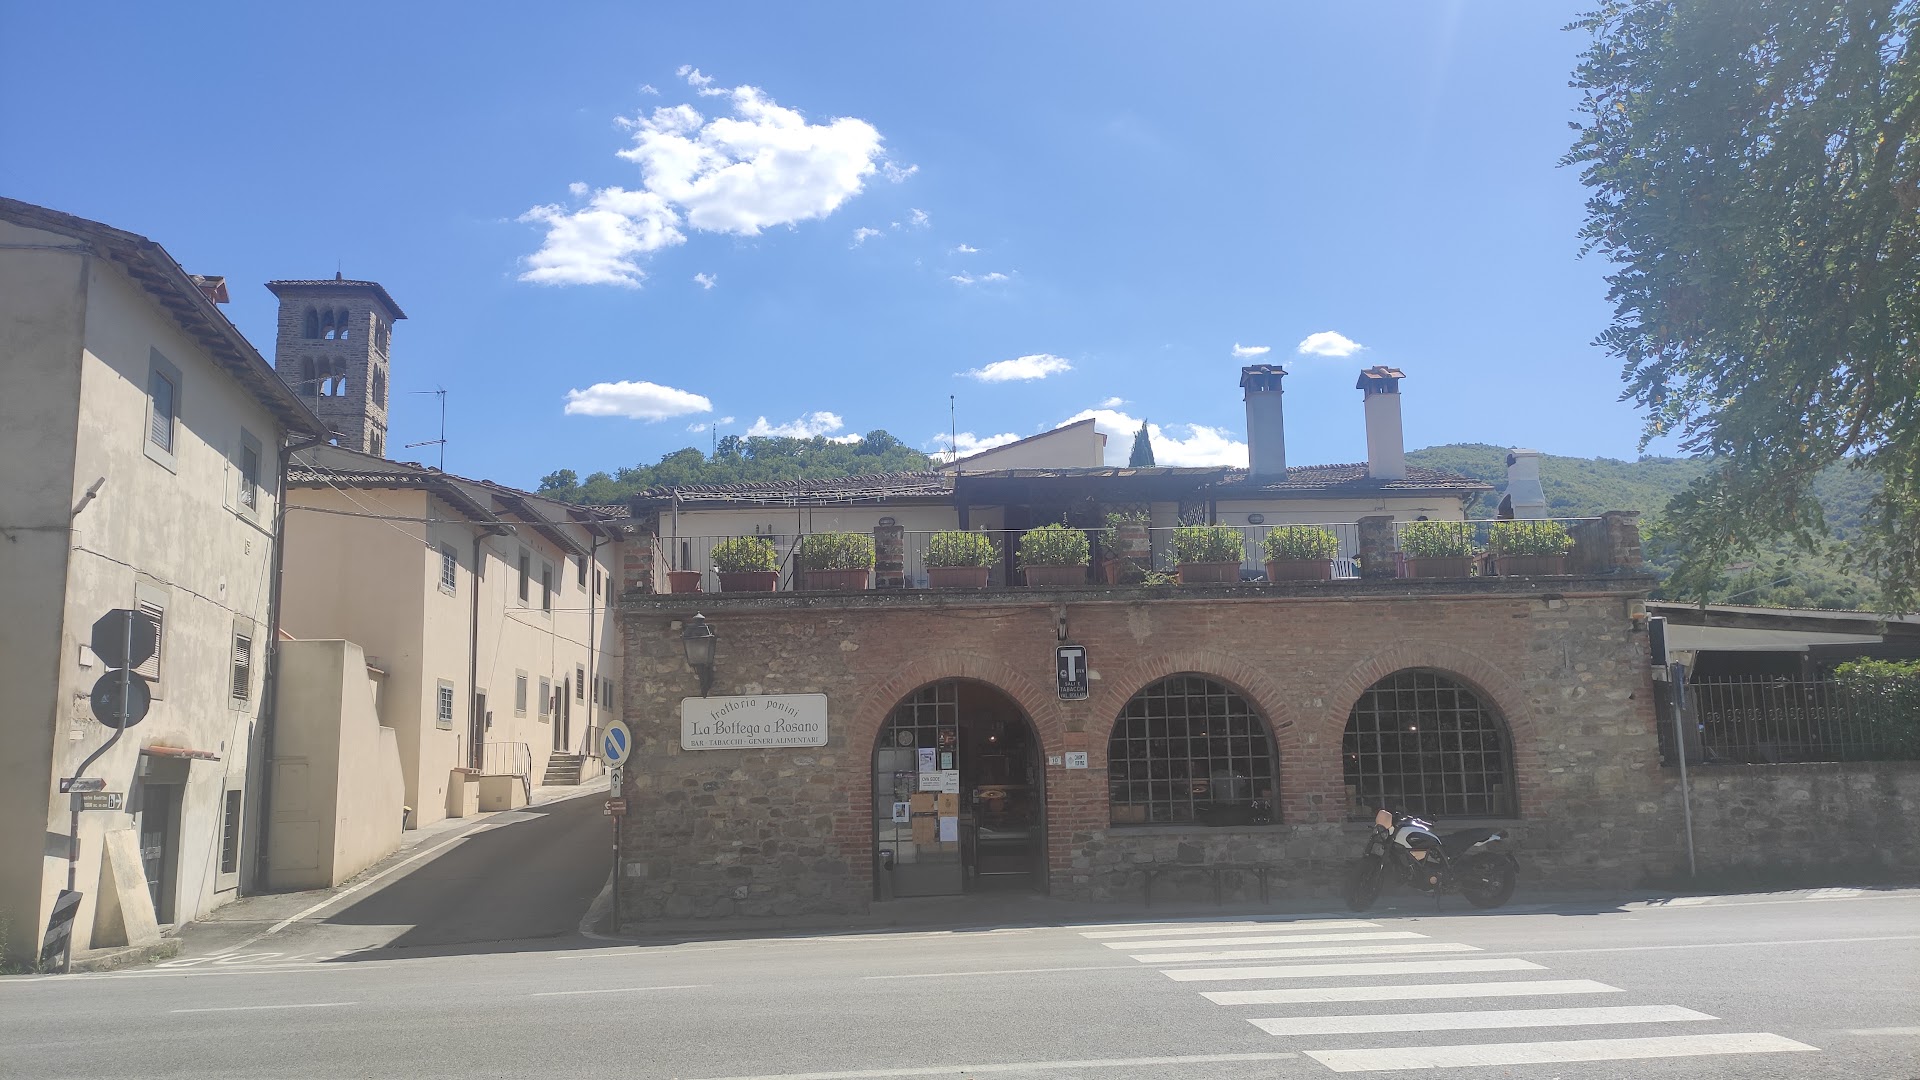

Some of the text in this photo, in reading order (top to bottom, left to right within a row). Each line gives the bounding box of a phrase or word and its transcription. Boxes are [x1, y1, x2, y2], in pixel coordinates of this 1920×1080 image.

[1060, 649, 1082, 682] T
[710, 698, 800, 721] trattoria panini
[691, 717, 819, 738] La Bottega a Rosano
